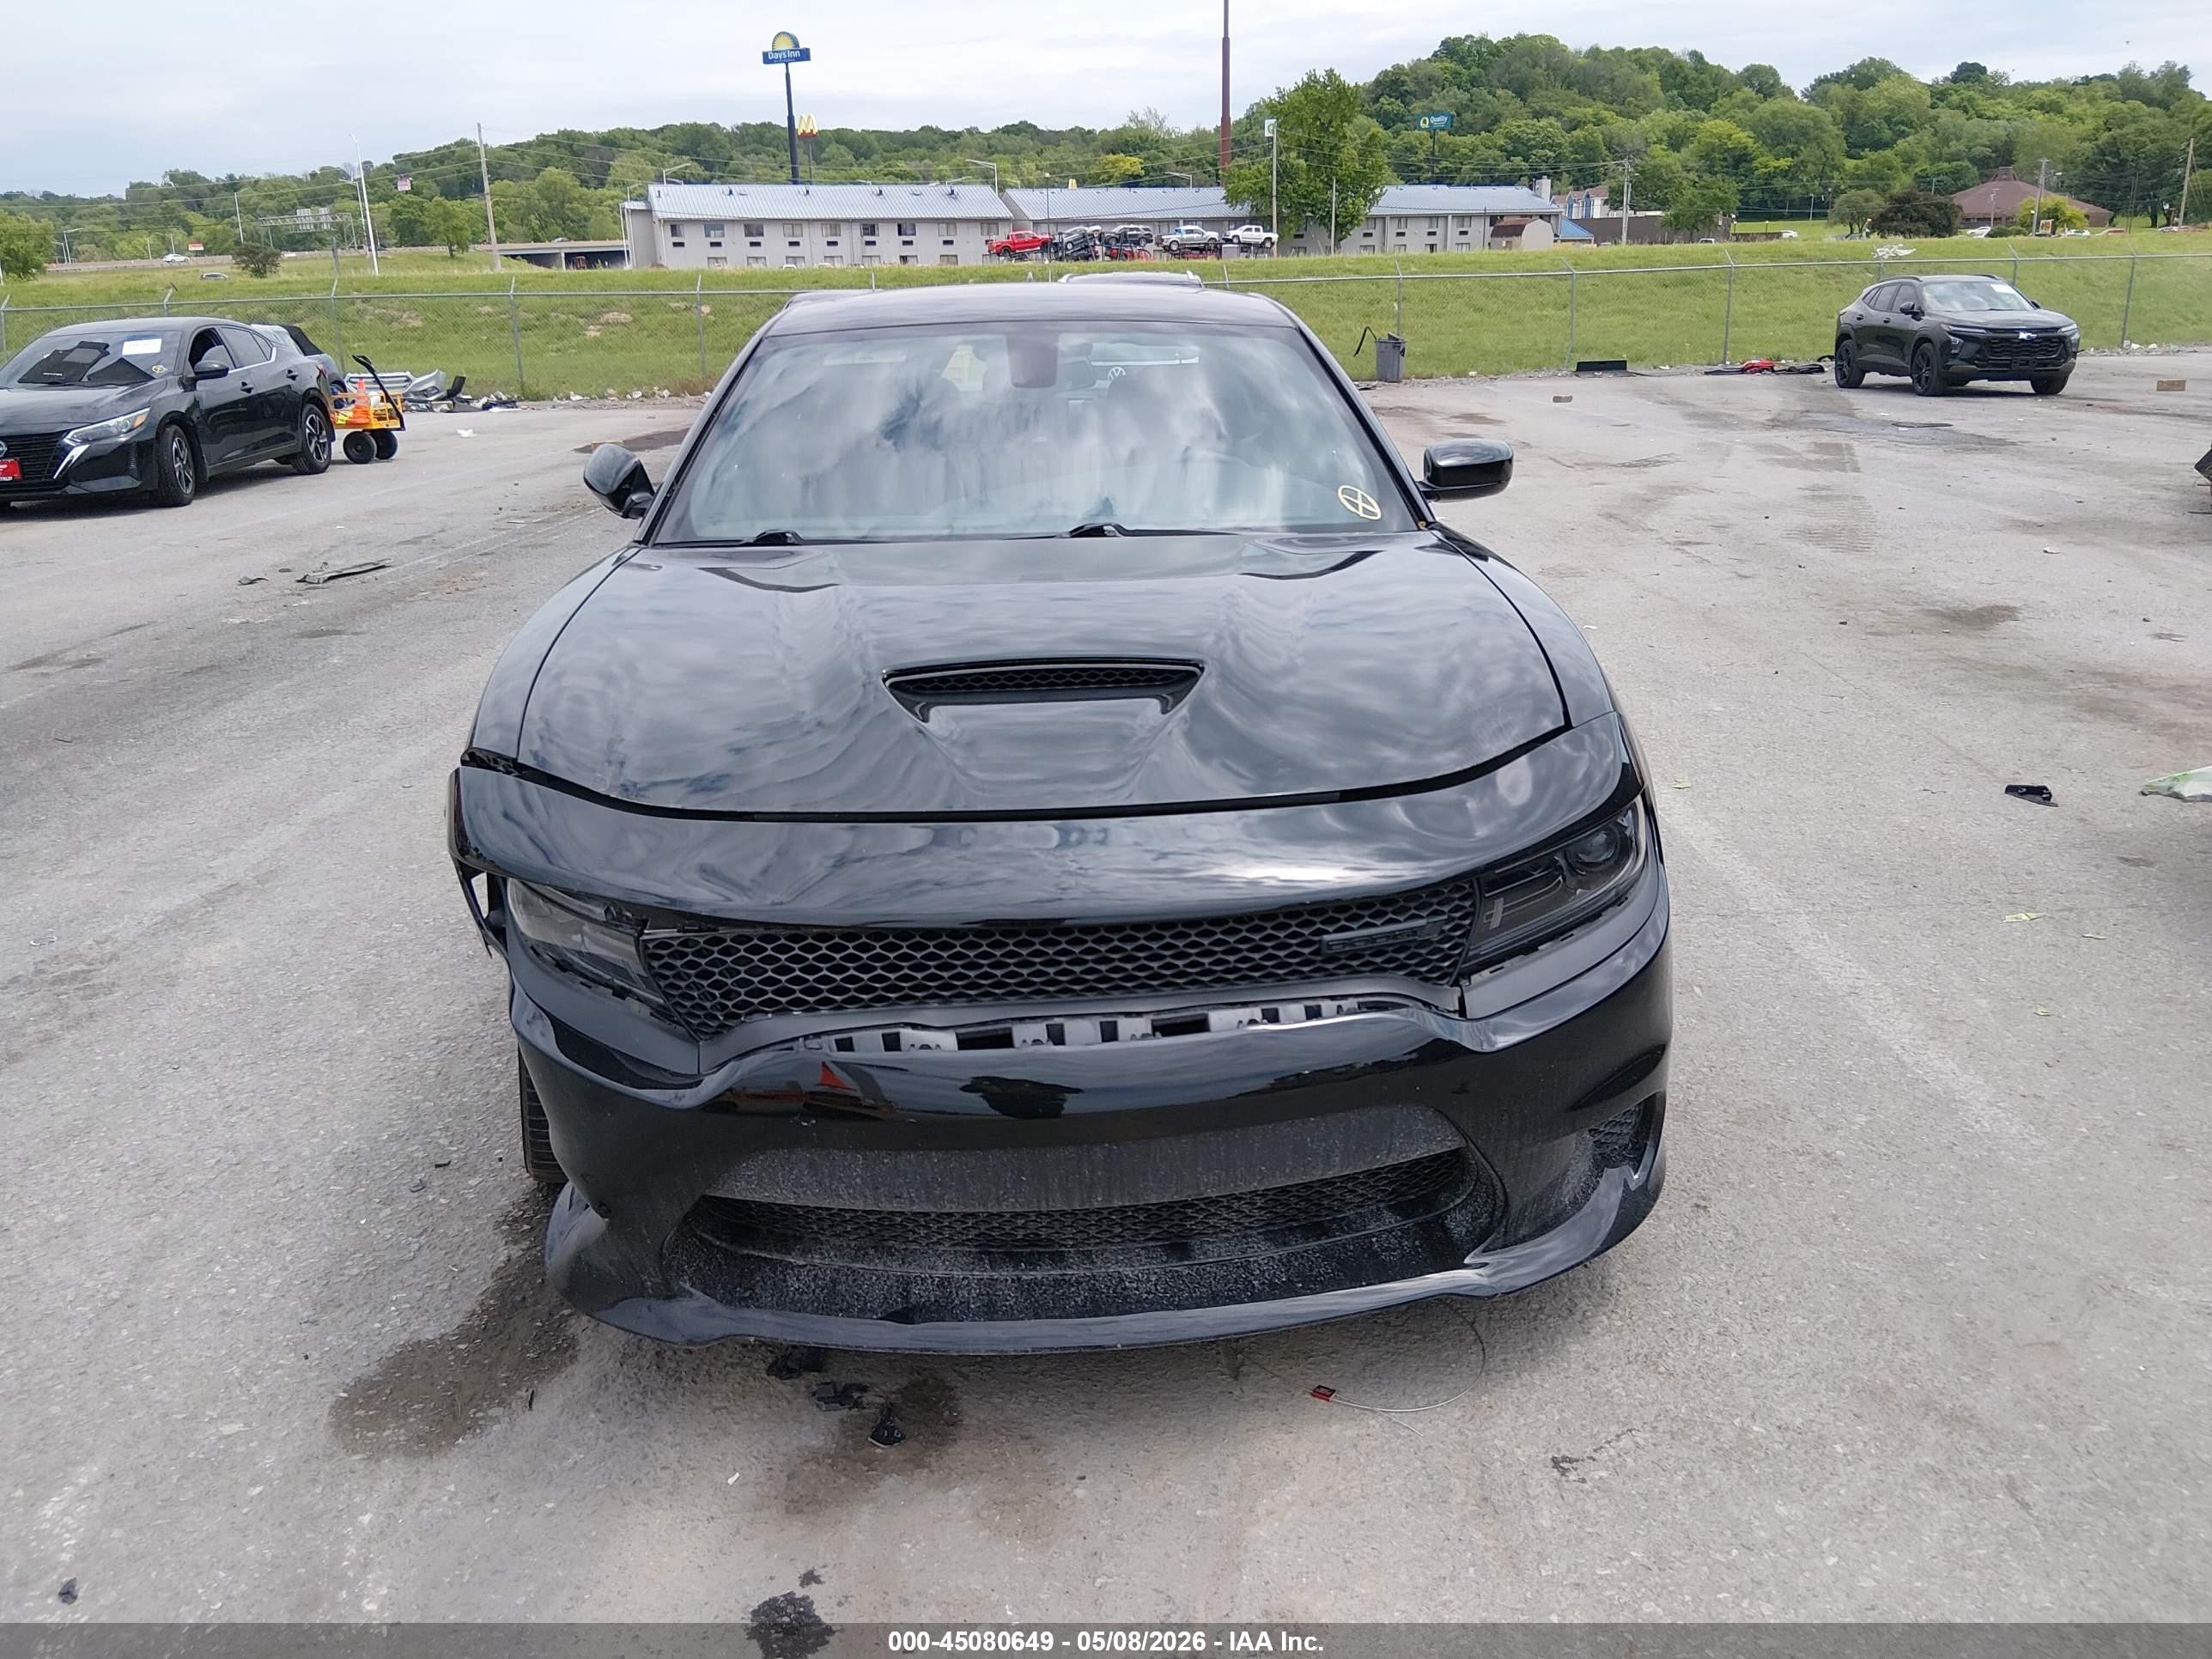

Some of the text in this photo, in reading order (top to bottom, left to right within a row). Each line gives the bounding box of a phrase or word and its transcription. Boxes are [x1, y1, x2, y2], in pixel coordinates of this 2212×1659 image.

[769, 50, 801, 60] Days Inn
[1430, 116, 1449, 125] Quality
